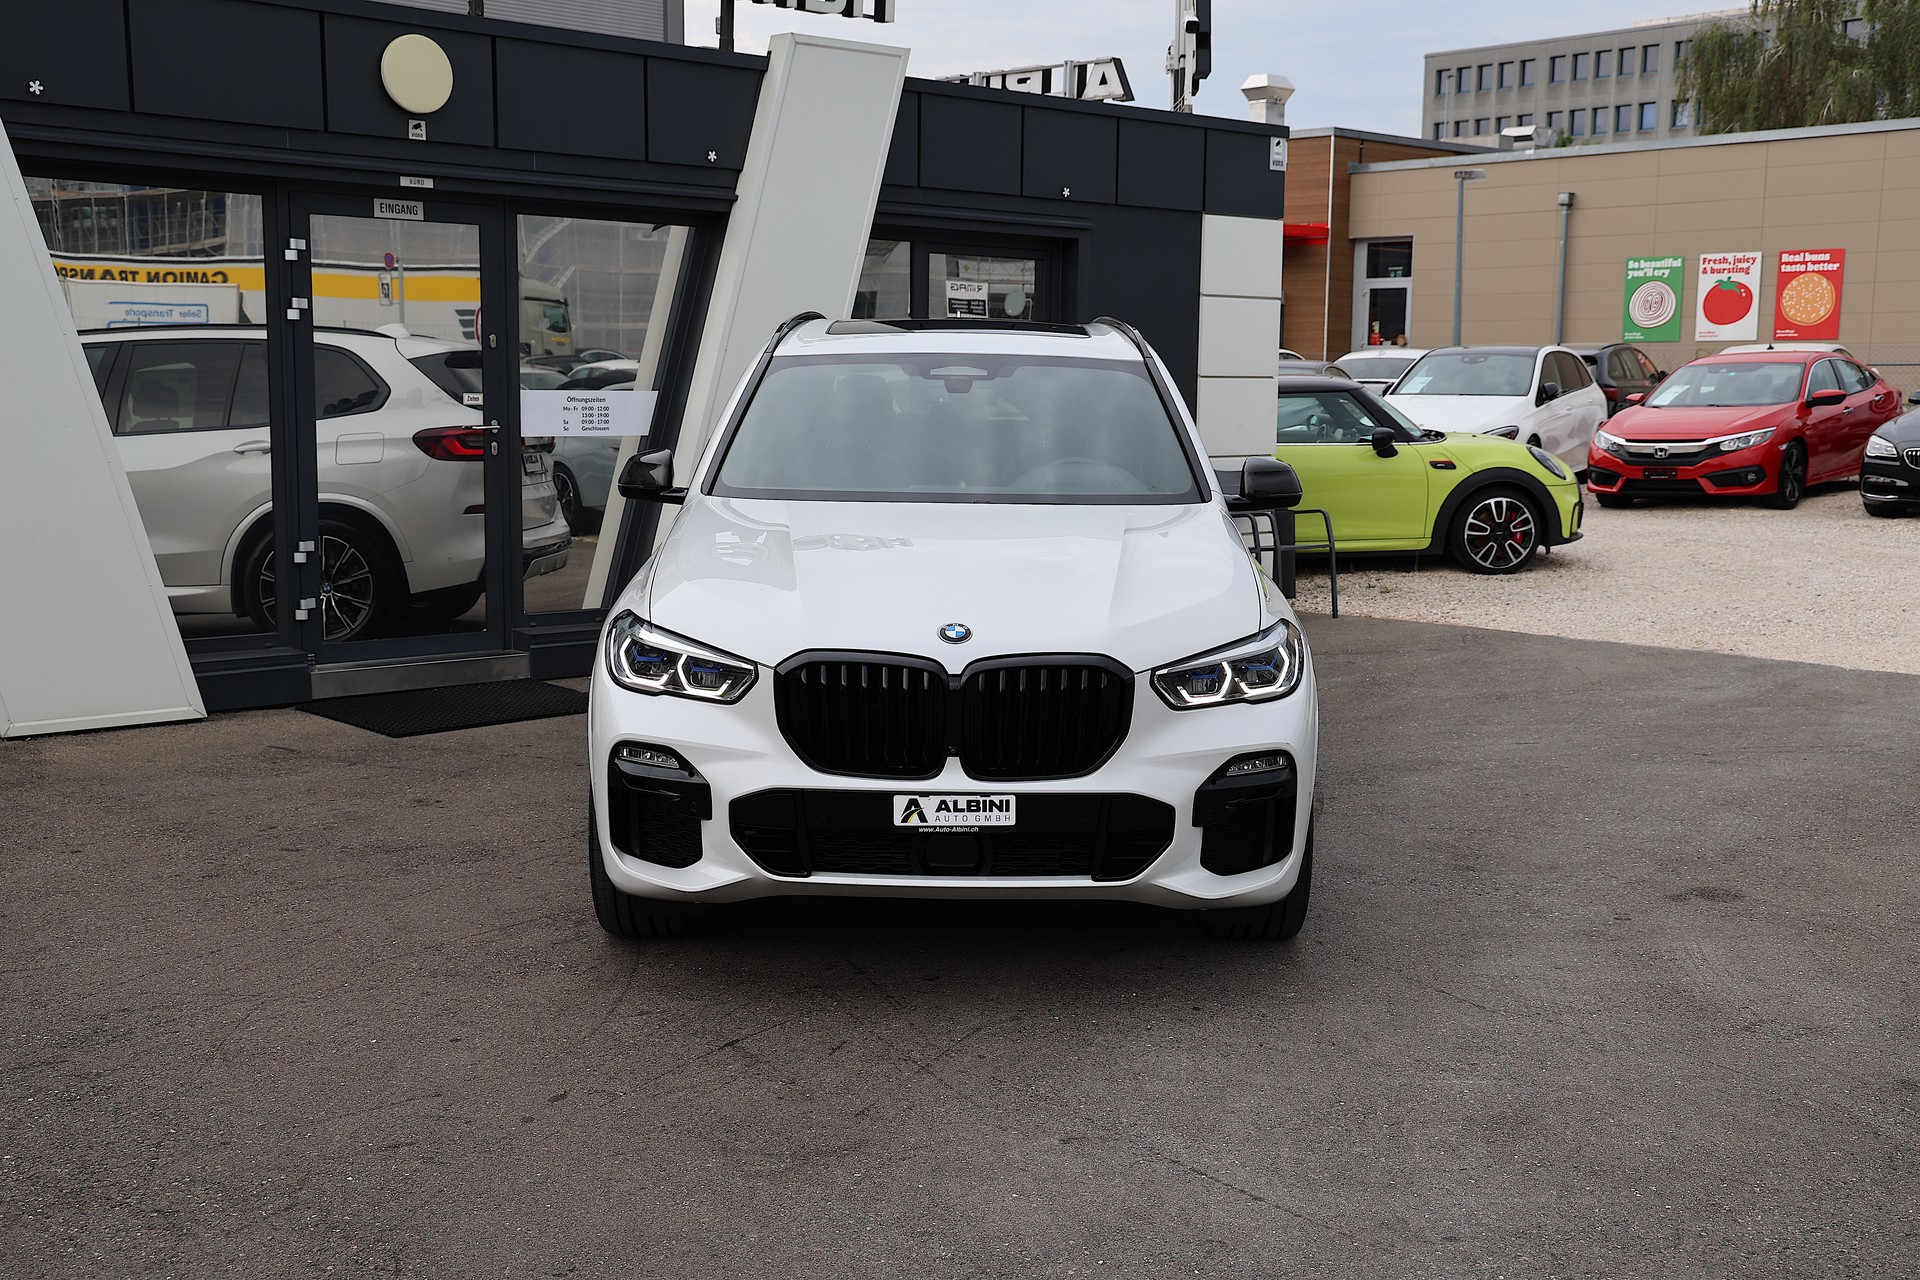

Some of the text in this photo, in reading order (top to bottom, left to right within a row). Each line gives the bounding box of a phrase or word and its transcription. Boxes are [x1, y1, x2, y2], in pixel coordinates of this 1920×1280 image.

[379, 202, 418, 215] EINGANG
[1702, 255, 1757, 265] Fresh, juicy
[1781, 252, 1830, 262] Real buns
[1627, 258, 1681, 268] So beautiful
[1780, 262, 1840, 272] taste better
[1654, 268, 1670, 278] cry
[1710, 265, 1750, 275] bursting
[935, 799, 1010, 813] ALBINI
